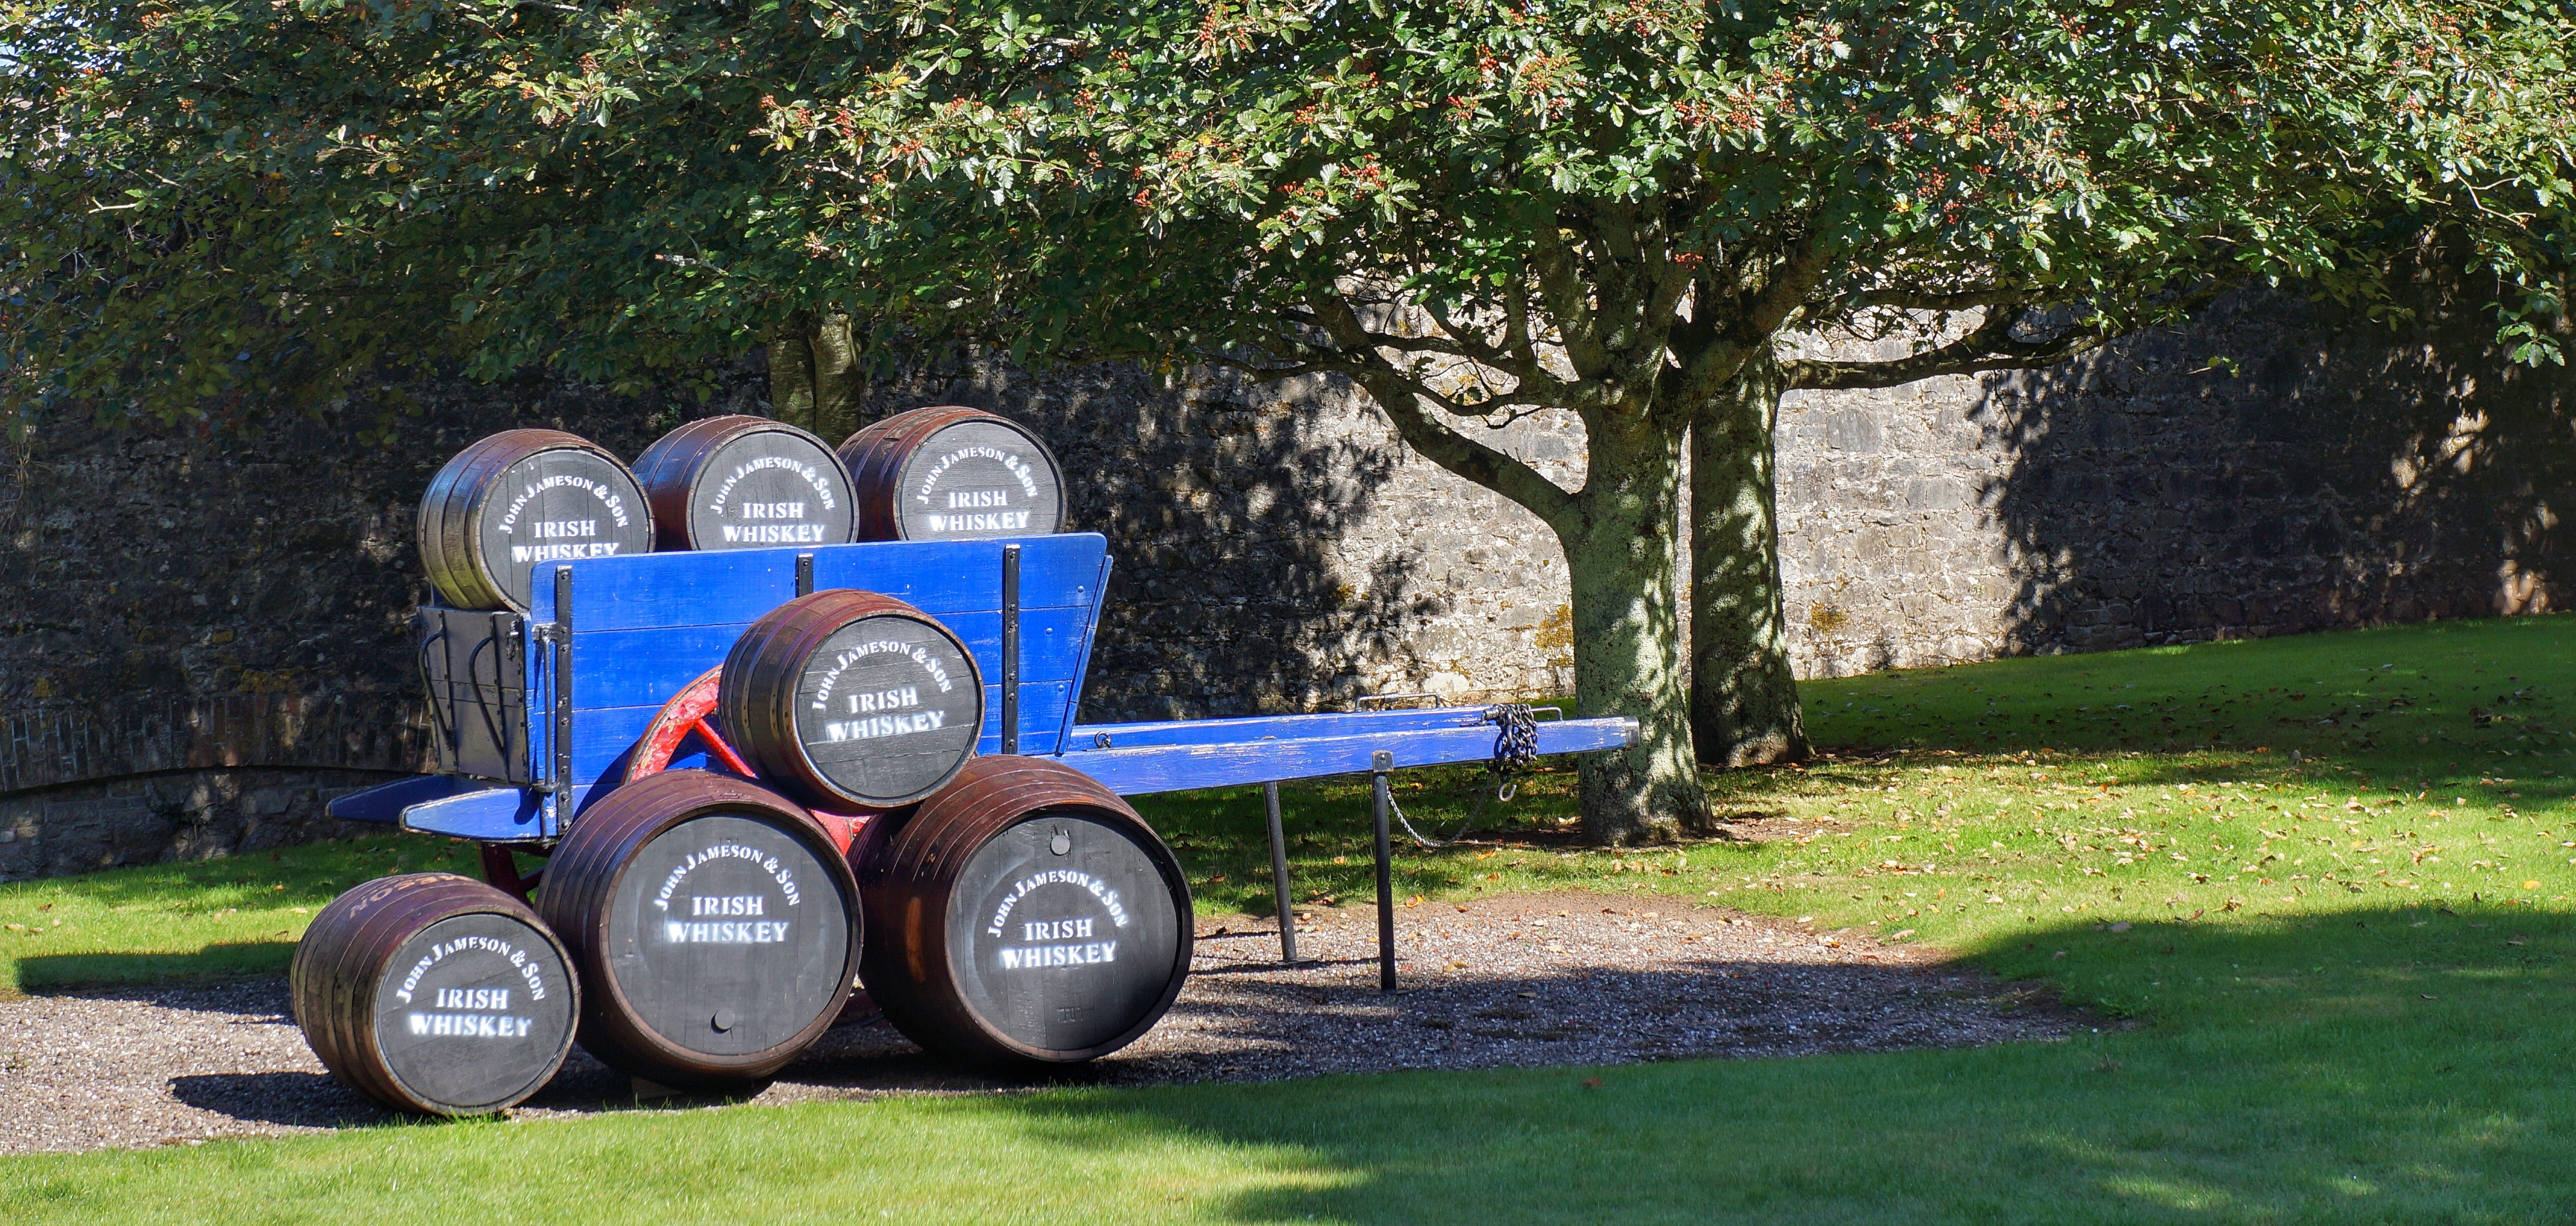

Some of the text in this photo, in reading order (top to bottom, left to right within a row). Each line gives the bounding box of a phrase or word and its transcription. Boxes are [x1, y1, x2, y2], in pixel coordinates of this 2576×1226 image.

[710, 457, 835, 514] JOHN JAMESON & SON
[917, 447, 1038, 504] JOHN JAMESON & SON
[499, 475, 628, 534] JOHN JAMESON & SON
[743, 502, 804, 518] IRISH
[949, 490, 1007, 508] IRISH
[534, 520, 596, 538] IRISH
[929, 511, 1029, 531] WHISKEY
[723, 524, 824, 542] WHISKEY
[512, 543, 619, 562] WHISKEY
[812, 641, 952, 710] JOHN JAMESON & SON
[849, 687, 918, 713] IRISH
[828, 711, 945, 742] WHISKEY
[654, 845, 800, 911] JOHN JAMESON & SON
[692, 896, 764, 916] IRISH
[988, 871, 1127, 938] JOHN JAMESON & SON
[667, 921, 789, 943] WHISKEY
[1025, 918, 1092, 941] IRISH
[1002, 941, 1116, 969] WHISKEY
[396, 937, 545, 1004] JOHN JAMESON & SON
[436, 988, 509, 1009] IRISH
[409, 1014, 532, 1037] WHISKEY
